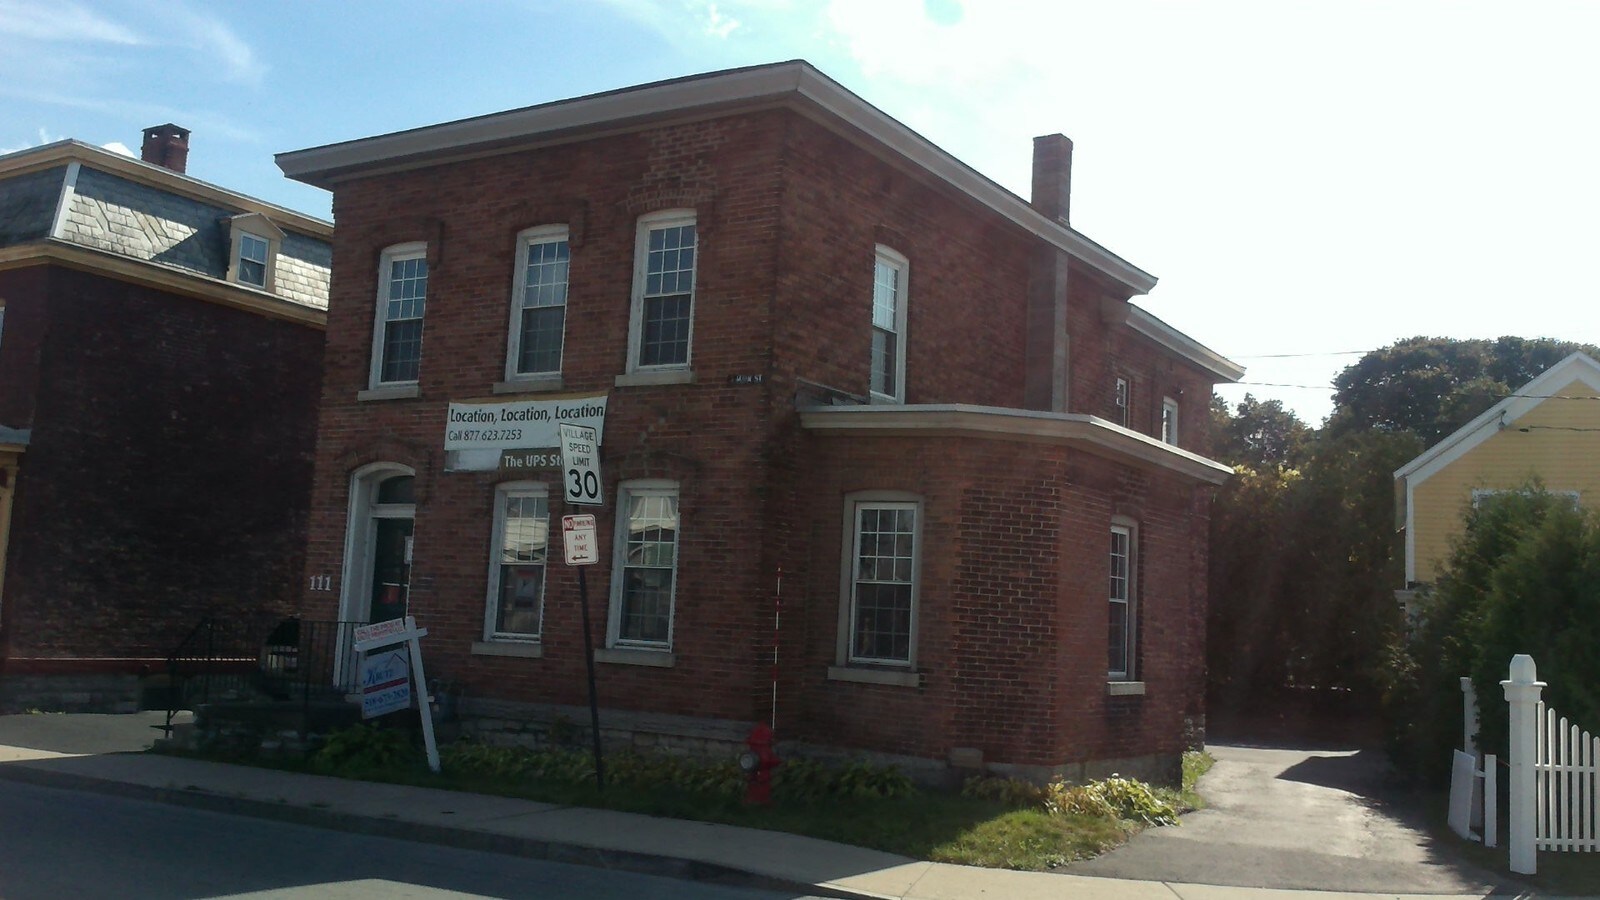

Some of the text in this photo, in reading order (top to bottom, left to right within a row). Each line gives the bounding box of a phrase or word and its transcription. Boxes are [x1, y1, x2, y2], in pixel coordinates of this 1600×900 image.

[450, 403, 604, 425] Location, Location, Location
[448, 429, 522, 442] Call 877.623.7253
[563, 428, 594, 441] VILLAGE
[569, 443, 591, 454] SPEED
[505, 455, 522, 468] The
[525, 454, 547, 467] UPS
[572, 457, 590, 466] LIMIT
[568, 469, 598, 499] 30
[564, 519, 574, 529] NO
[310, 575, 332, 591] 111
